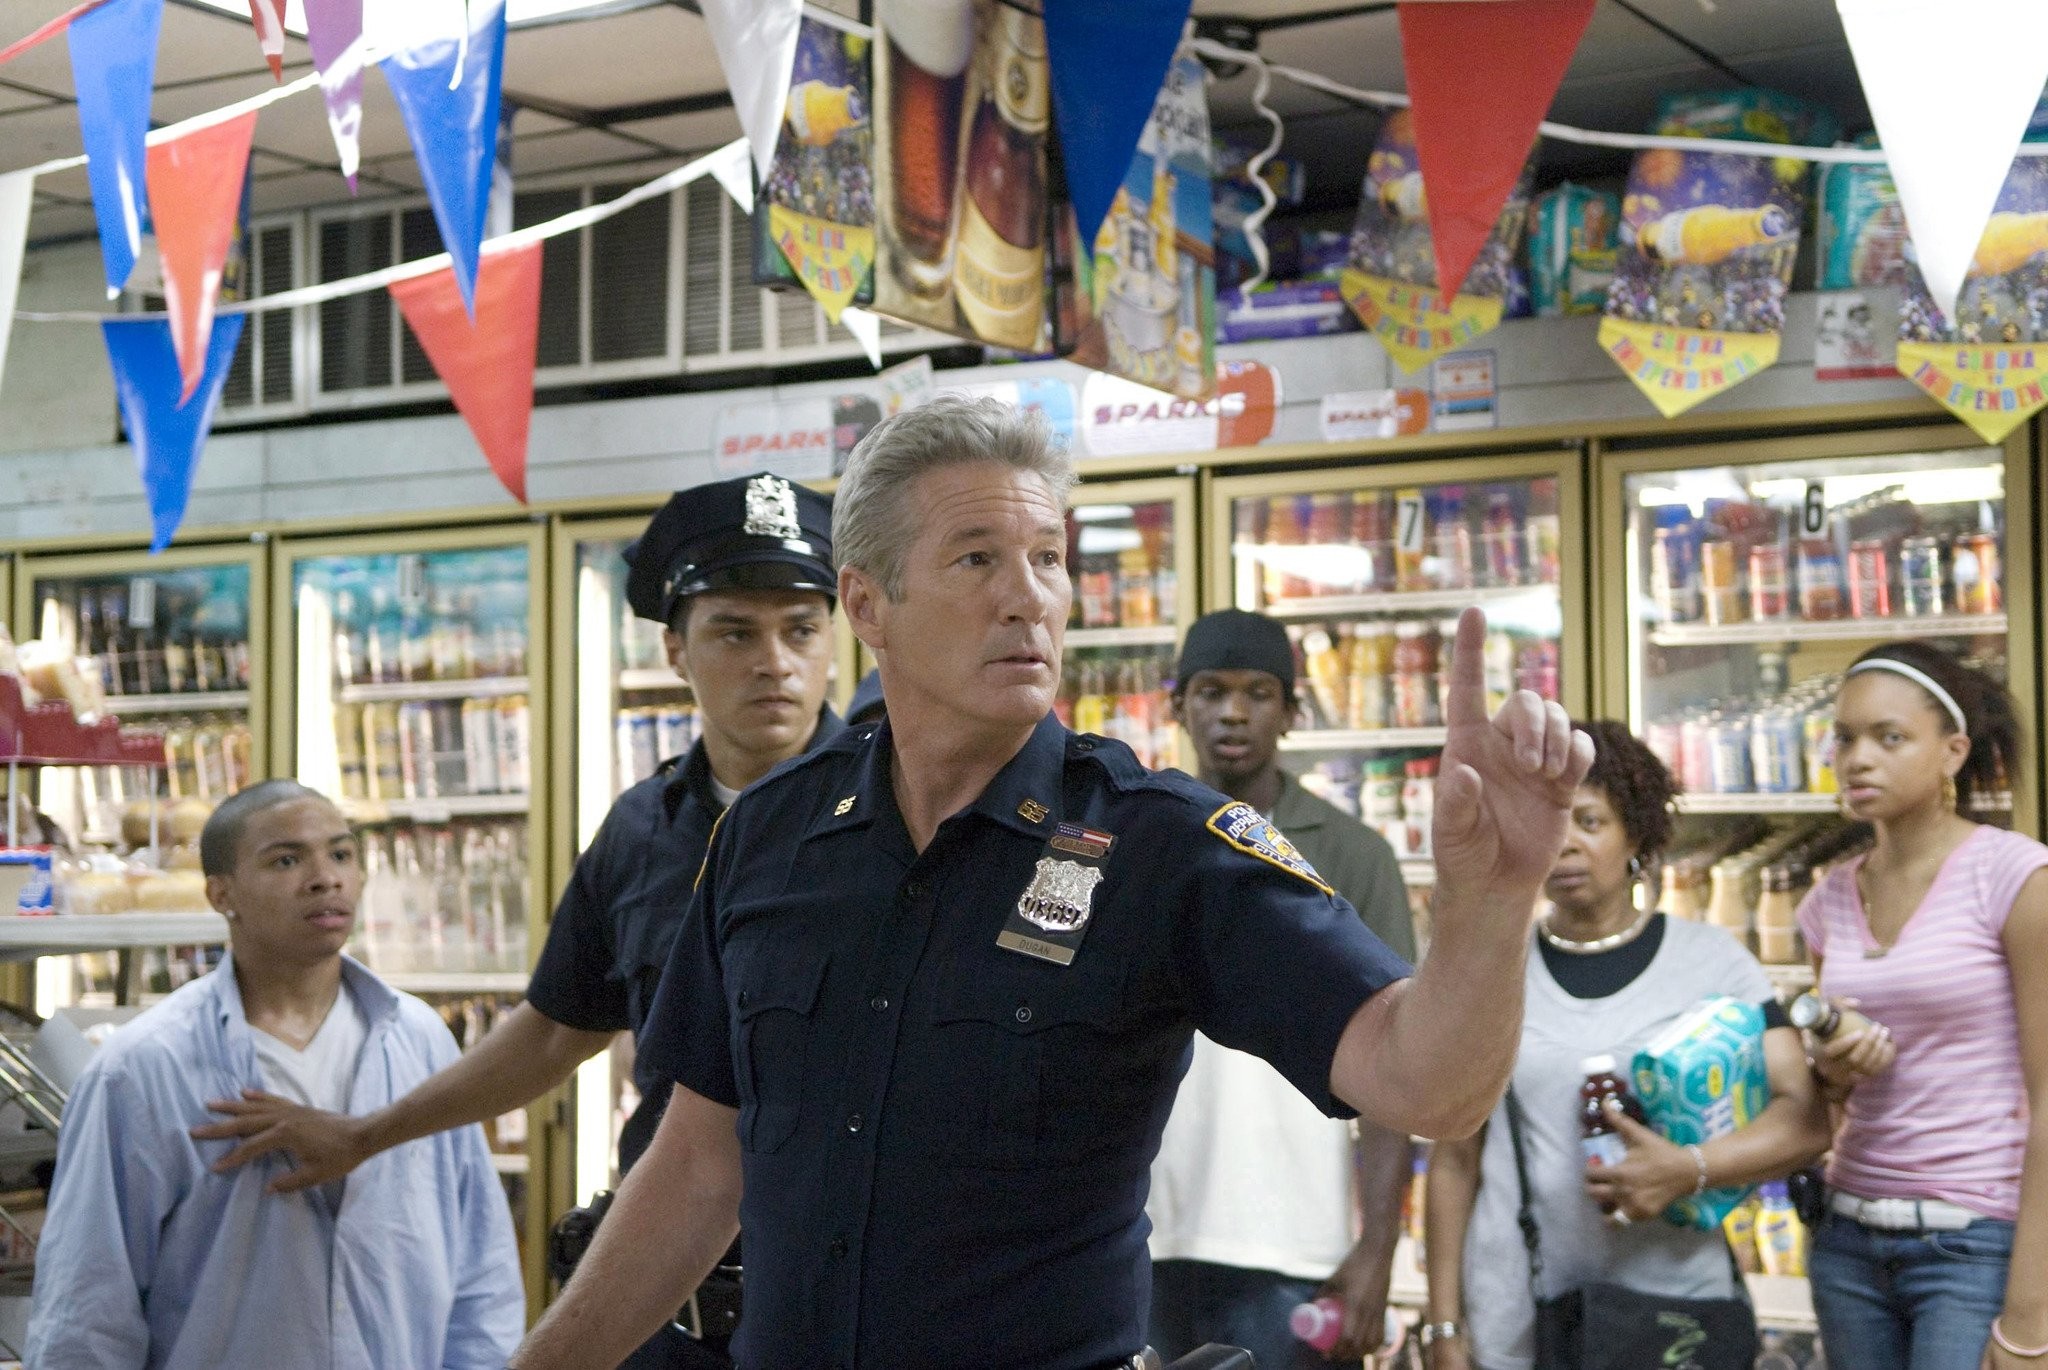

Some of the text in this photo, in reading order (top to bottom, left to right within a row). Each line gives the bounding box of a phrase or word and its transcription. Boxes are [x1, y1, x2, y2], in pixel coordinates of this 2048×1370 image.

[1404, 501, 1419, 547] 7
[1806, 485, 1823, 533] 6
[1253, 843, 1286, 861] CITY
[1019, 939, 1050, 956] DUGAN
